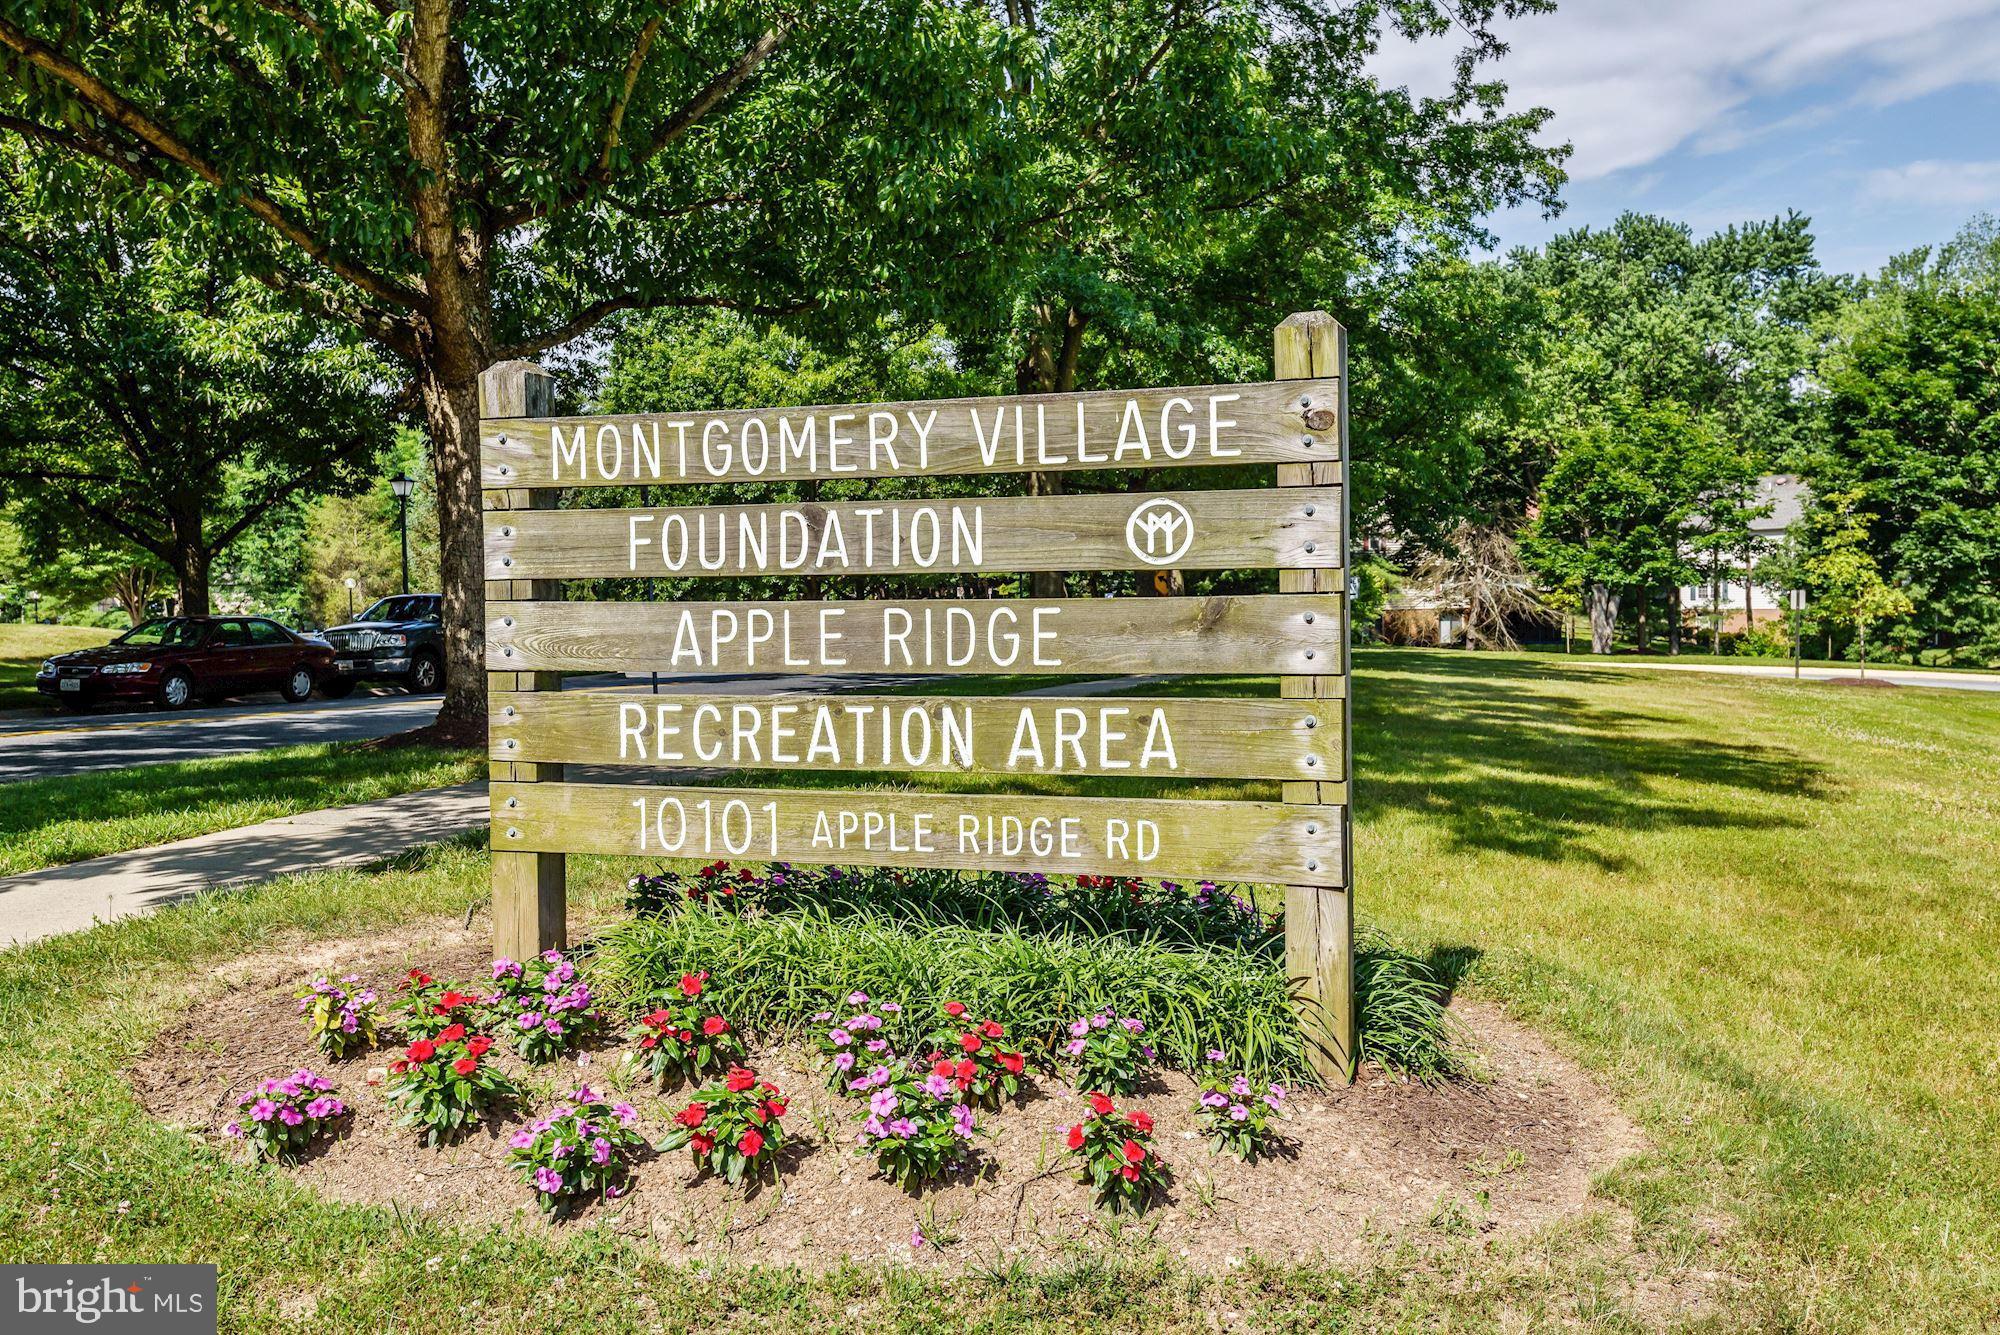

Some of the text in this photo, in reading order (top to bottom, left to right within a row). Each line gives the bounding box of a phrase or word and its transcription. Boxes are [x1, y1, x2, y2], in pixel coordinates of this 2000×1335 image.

[551, 393, 1242, 481] MONTGOMERY VILLAGE
[629, 506, 983, 571] FOUNDATION
[670, 606, 1062, 667] APPLE RIDGE
[619, 702, 1178, 769] RECREATION AREA
[632, 797, 1160, 861] 10101 APPLE RIDGE RD
